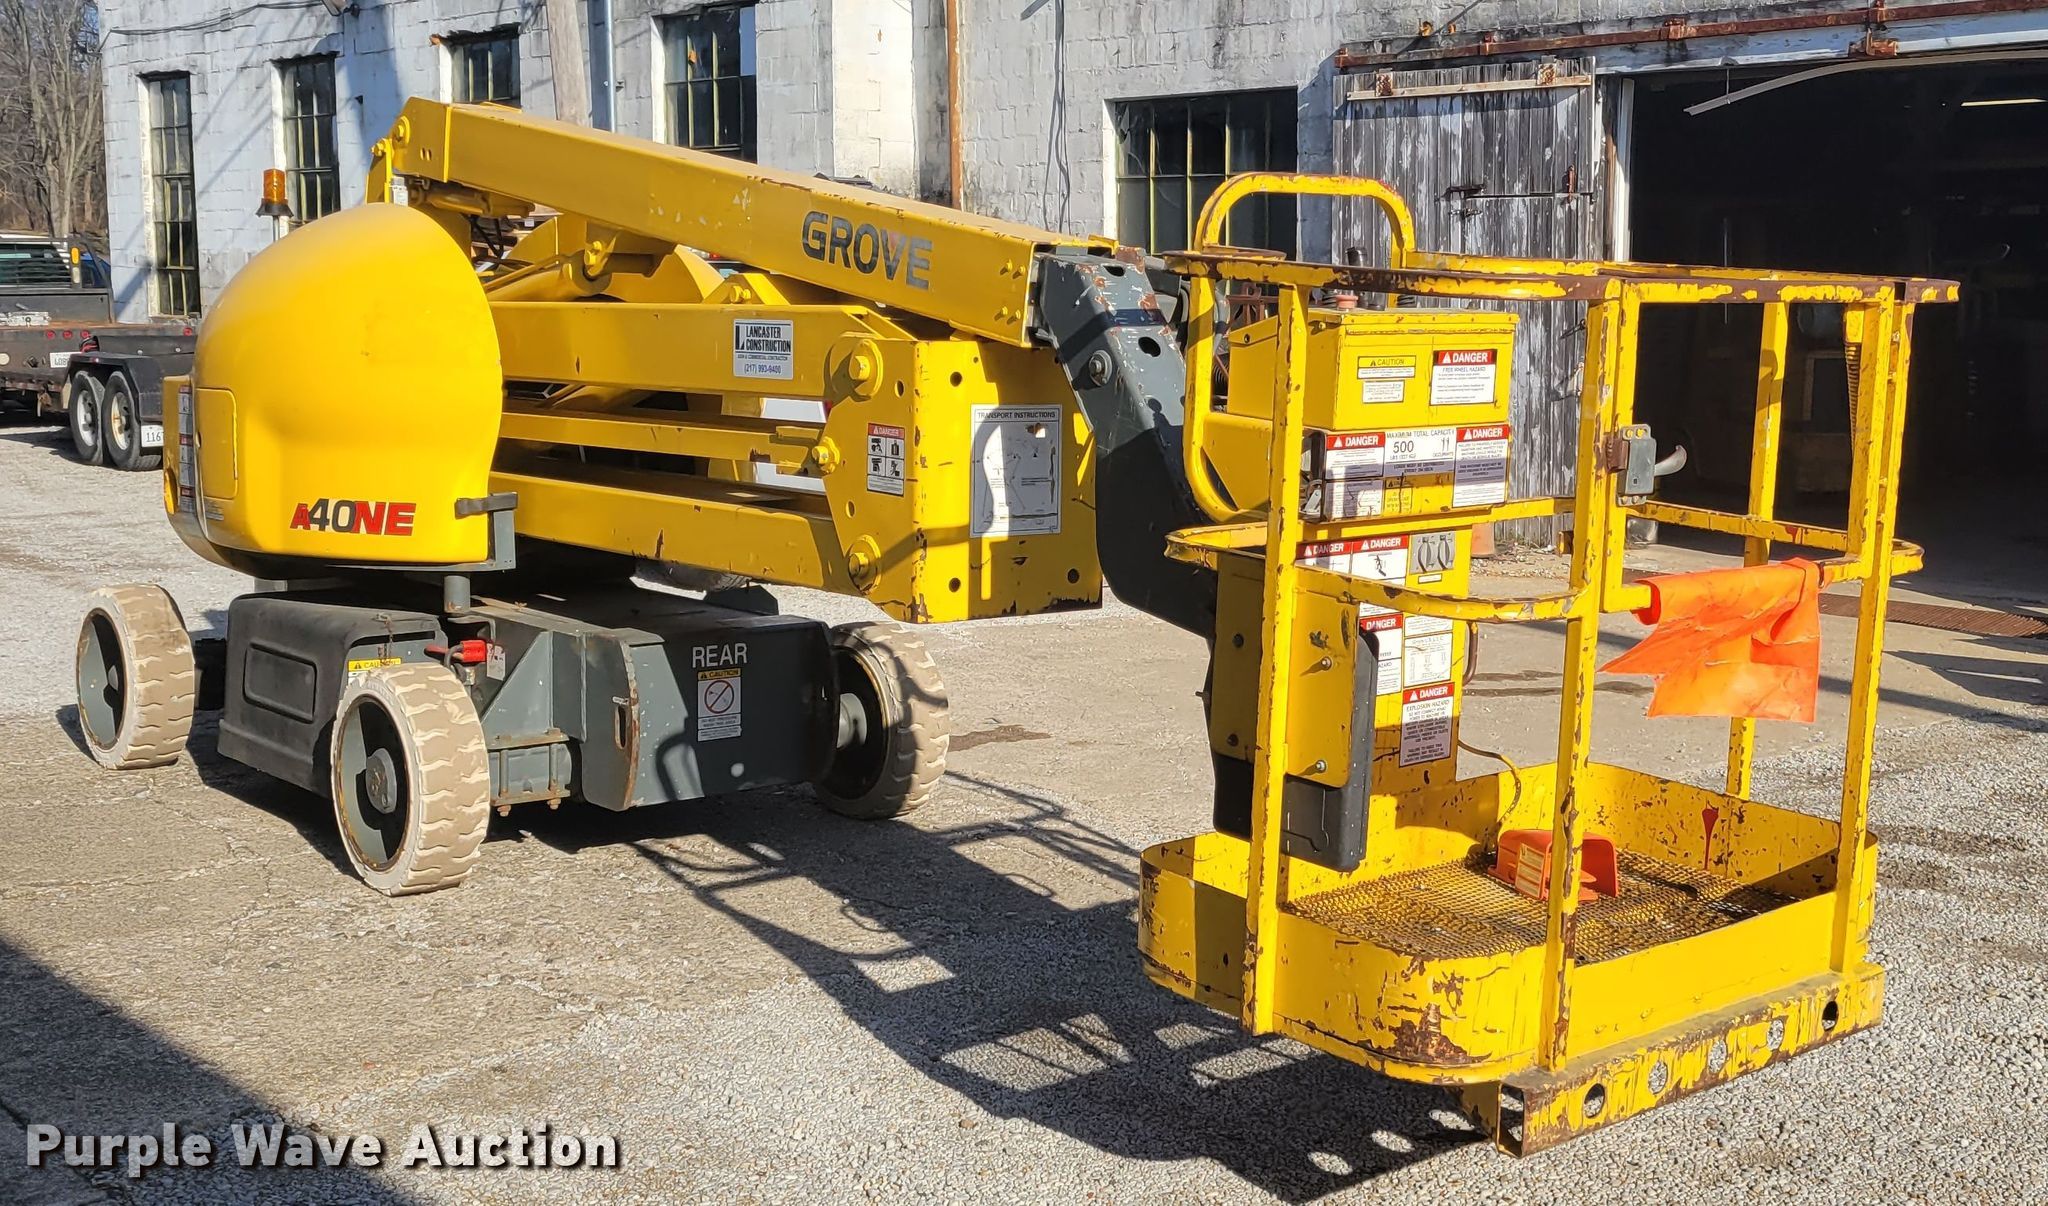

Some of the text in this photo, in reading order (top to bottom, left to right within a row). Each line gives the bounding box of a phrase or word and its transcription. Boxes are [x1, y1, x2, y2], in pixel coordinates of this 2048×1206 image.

[802, 211, 933, 290] GROVE
[746, 326, 781, 338] LANCASTER
[746, 339, 791, 352] CONSTRUCTION
[1452, 352, 1488, 363] DANGER
[1472, 428, 1503, 438] DANGER
[1345, 436, 1379, 447] DANGER
[1393, 440, 1414, 453] 500
[1441, 437, 1450, 451] 11
[290, 498, 416, 536] A40NE
[1313, 543, 1344, 555] DANGER
[1370, 538, 1401, 548] DANGER
[1366, 619, 1396, 630] DANGER
[692, 643, 747, 668] REAR
[709, 669, 738, 677] CAUTION
[1420, 686, 1448, 698] DANGER
